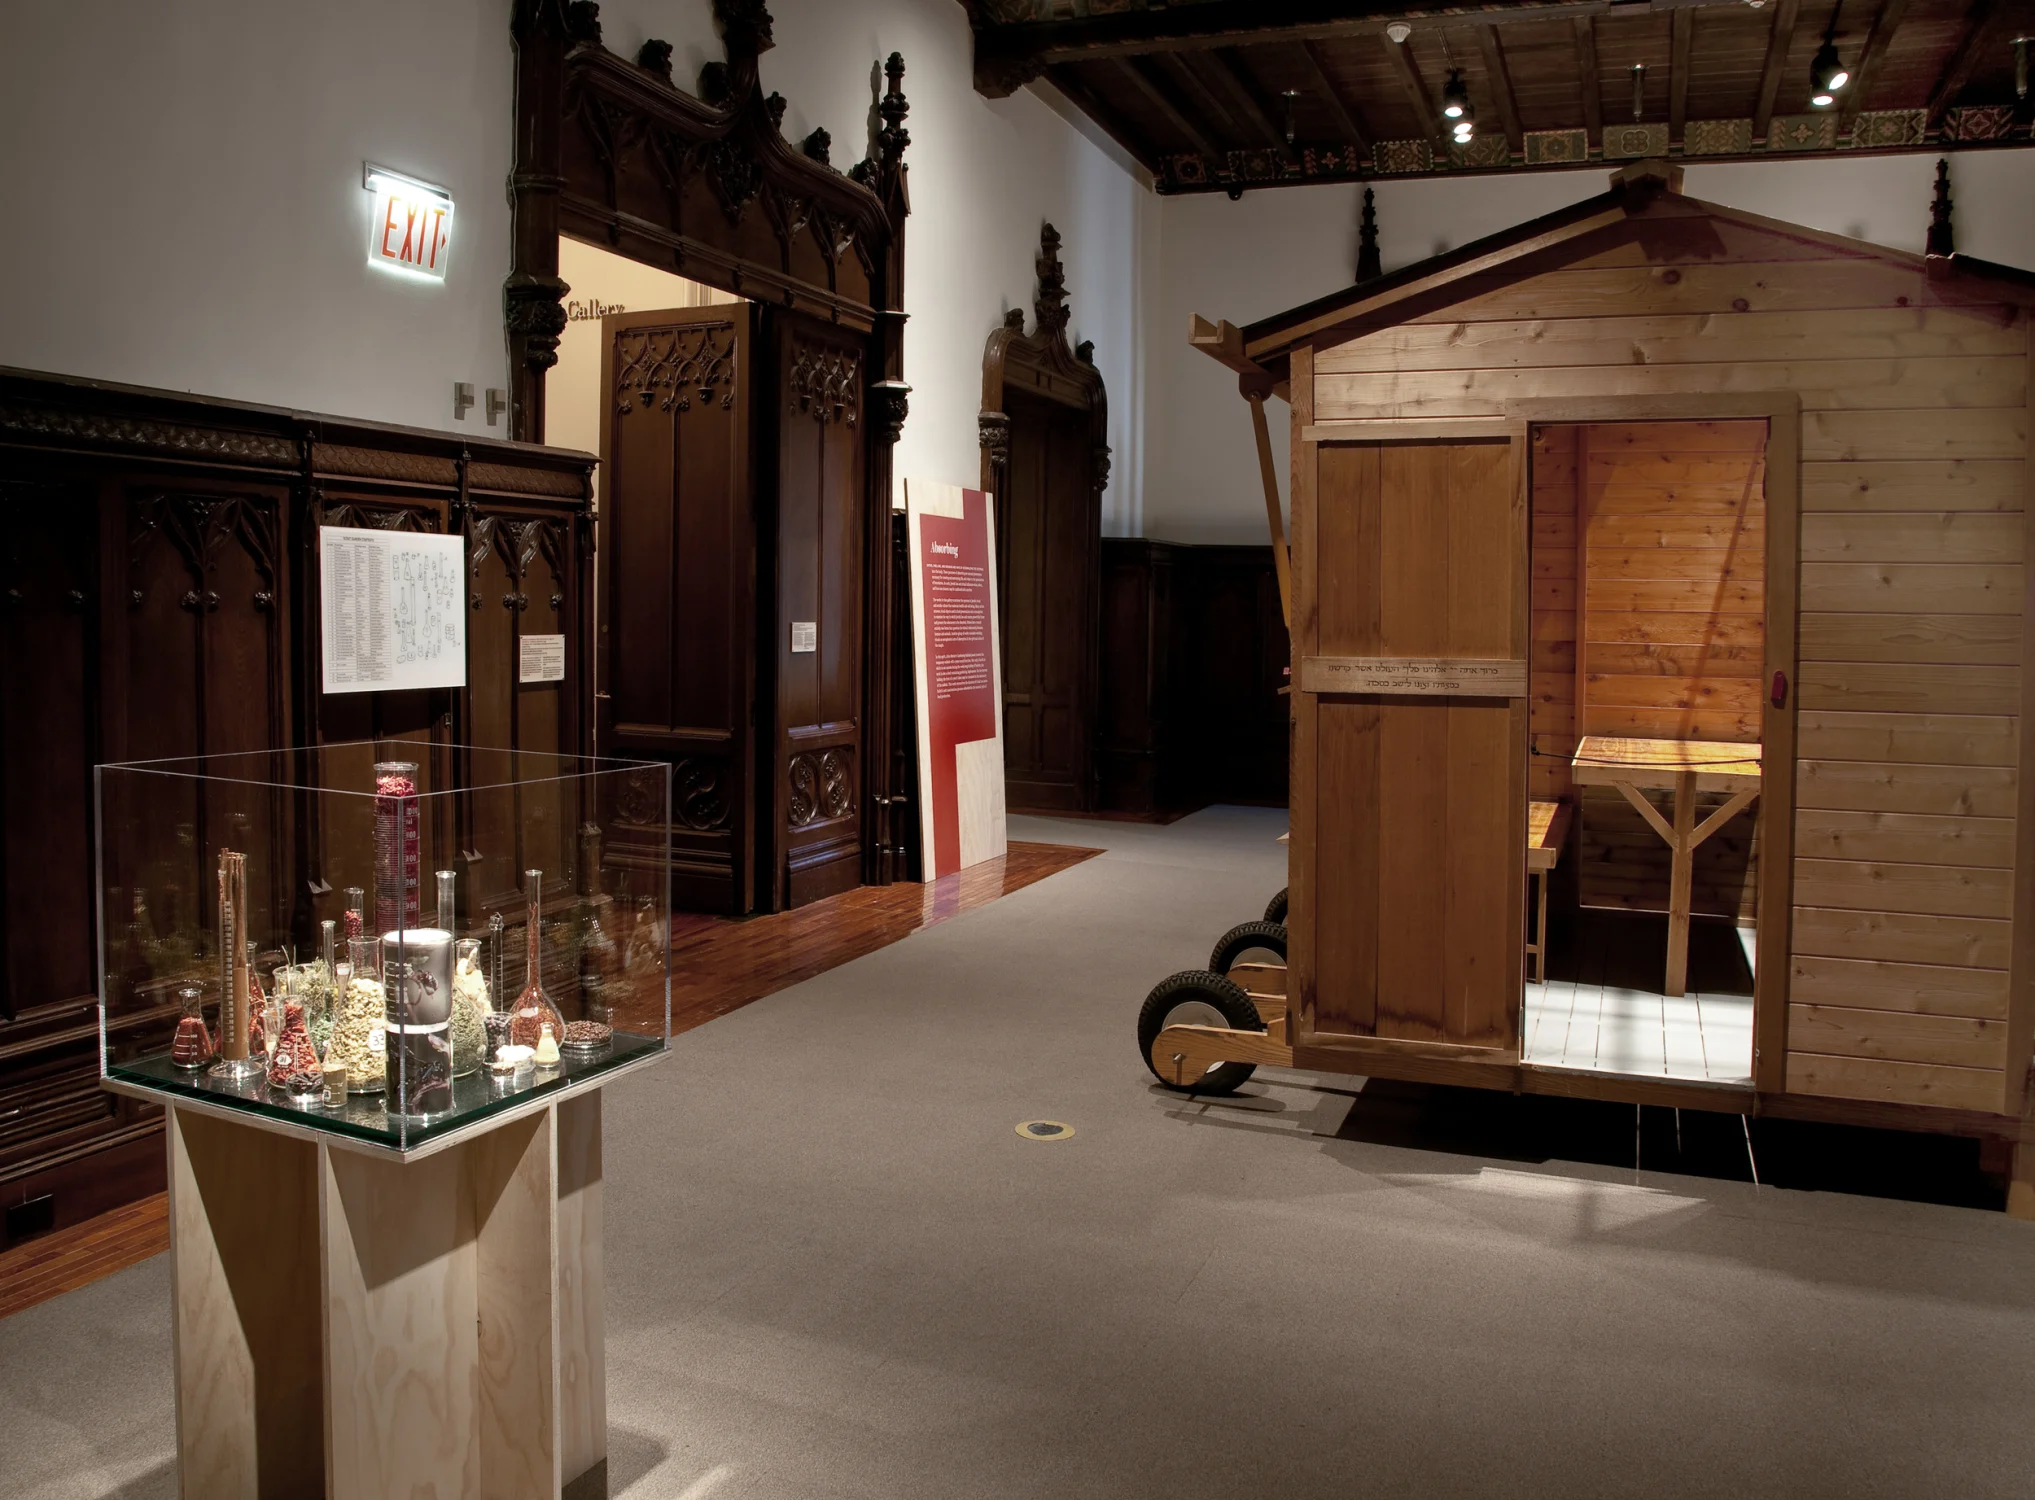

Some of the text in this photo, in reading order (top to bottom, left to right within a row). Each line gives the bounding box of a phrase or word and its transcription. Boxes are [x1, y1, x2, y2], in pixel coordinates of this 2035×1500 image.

[381, 194, 446, 269] EXIT
[567, 298, 626, 321] Gallery
[930, 540, 959, 559] Absorbing
